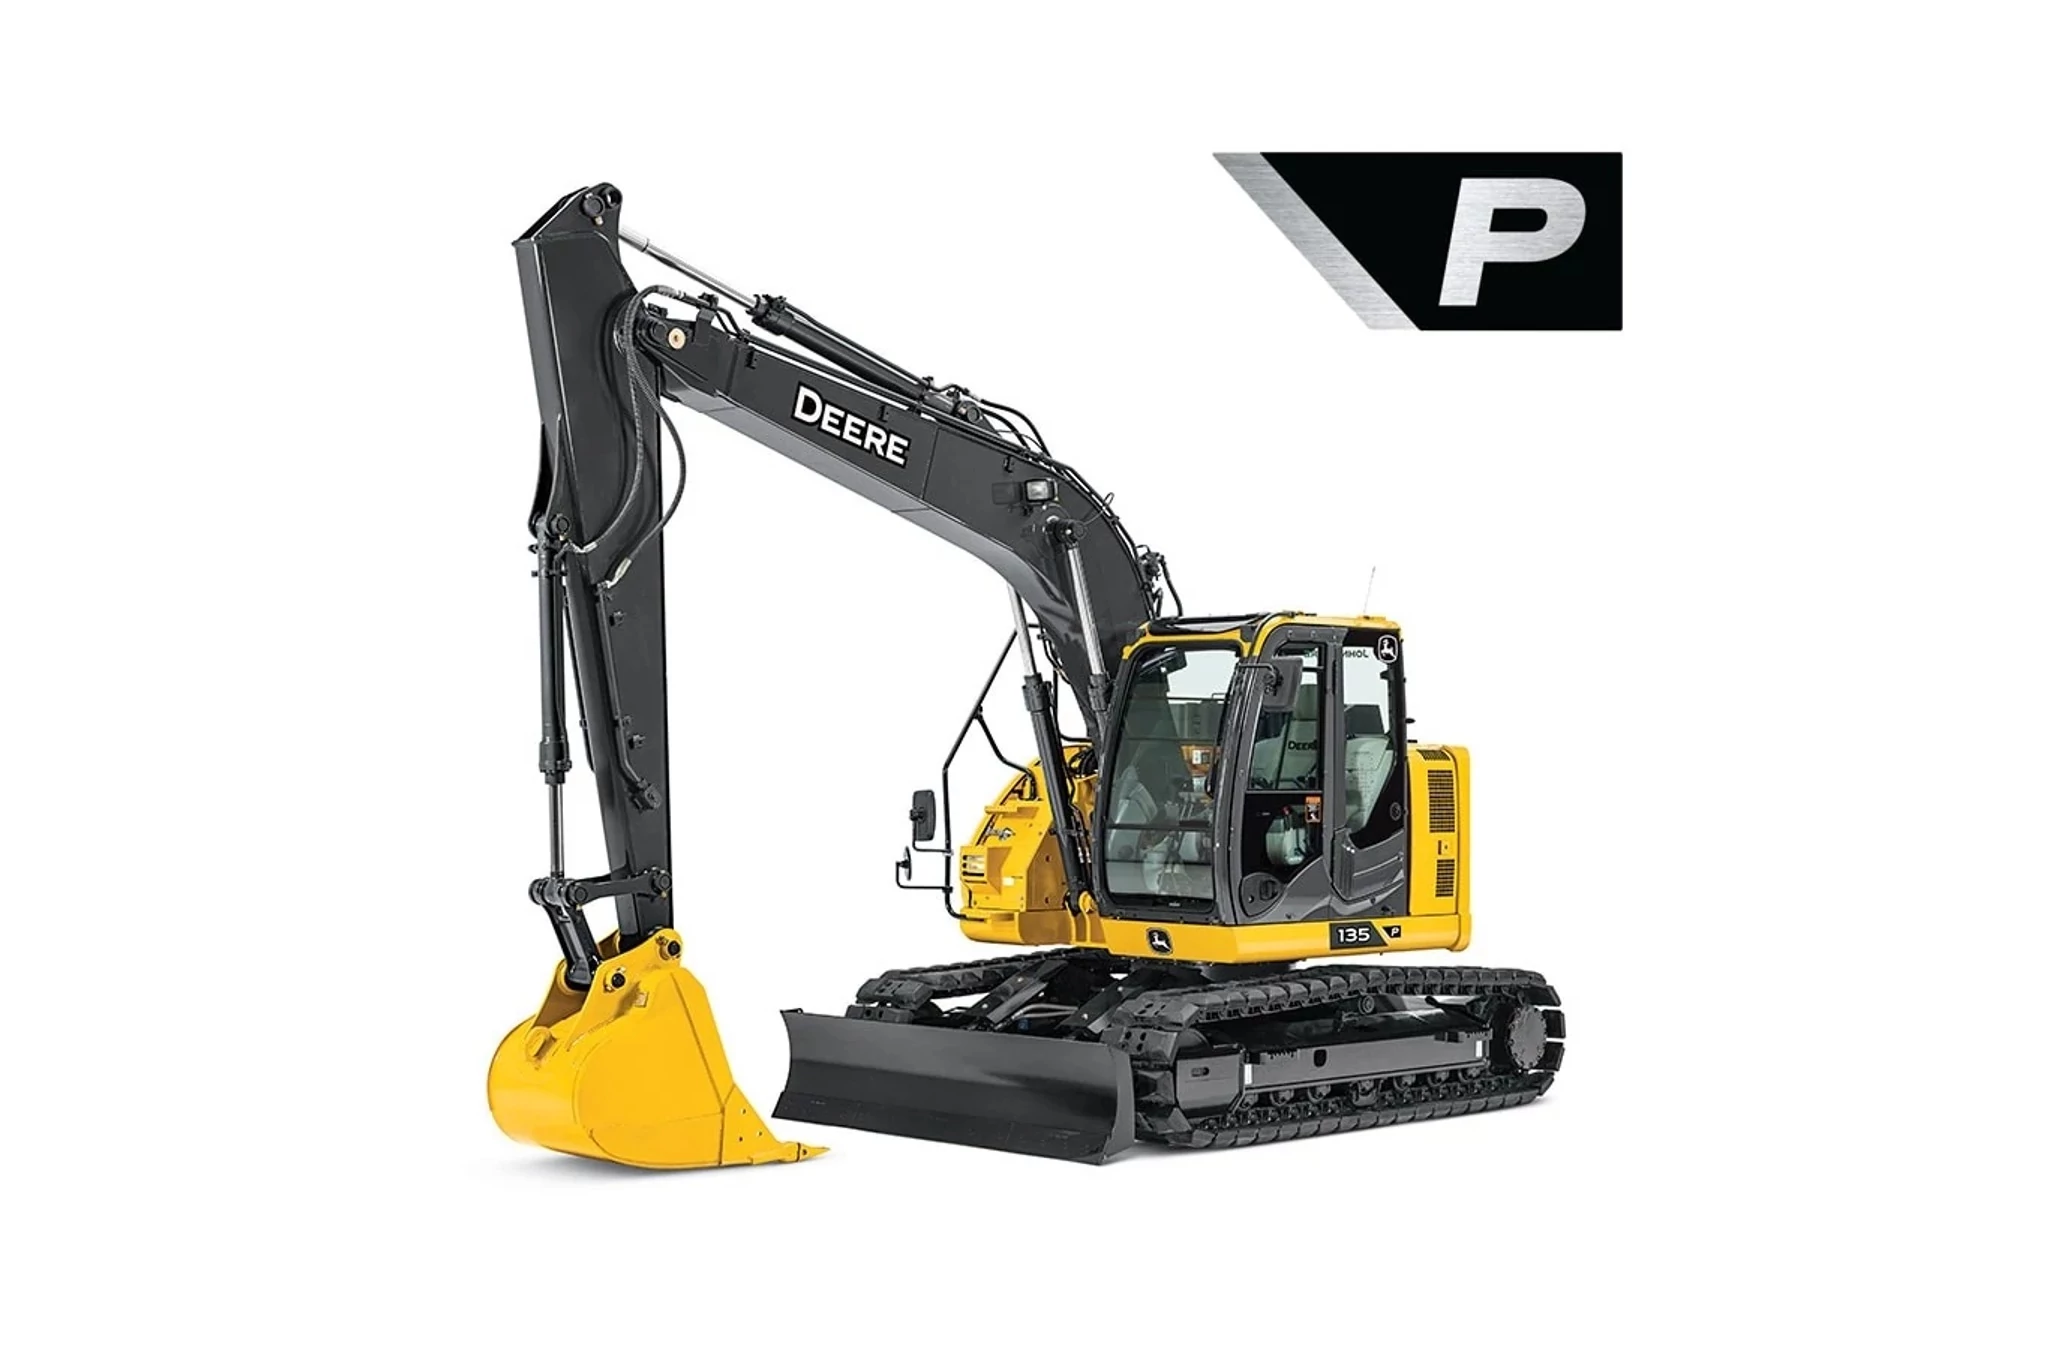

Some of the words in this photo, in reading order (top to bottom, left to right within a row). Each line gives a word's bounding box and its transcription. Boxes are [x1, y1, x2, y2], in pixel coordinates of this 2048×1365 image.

[794, 385, 909, 465] DEERE
[1338, 927, 1370, 943] 135
[1391, 926, 1399, 937] P
